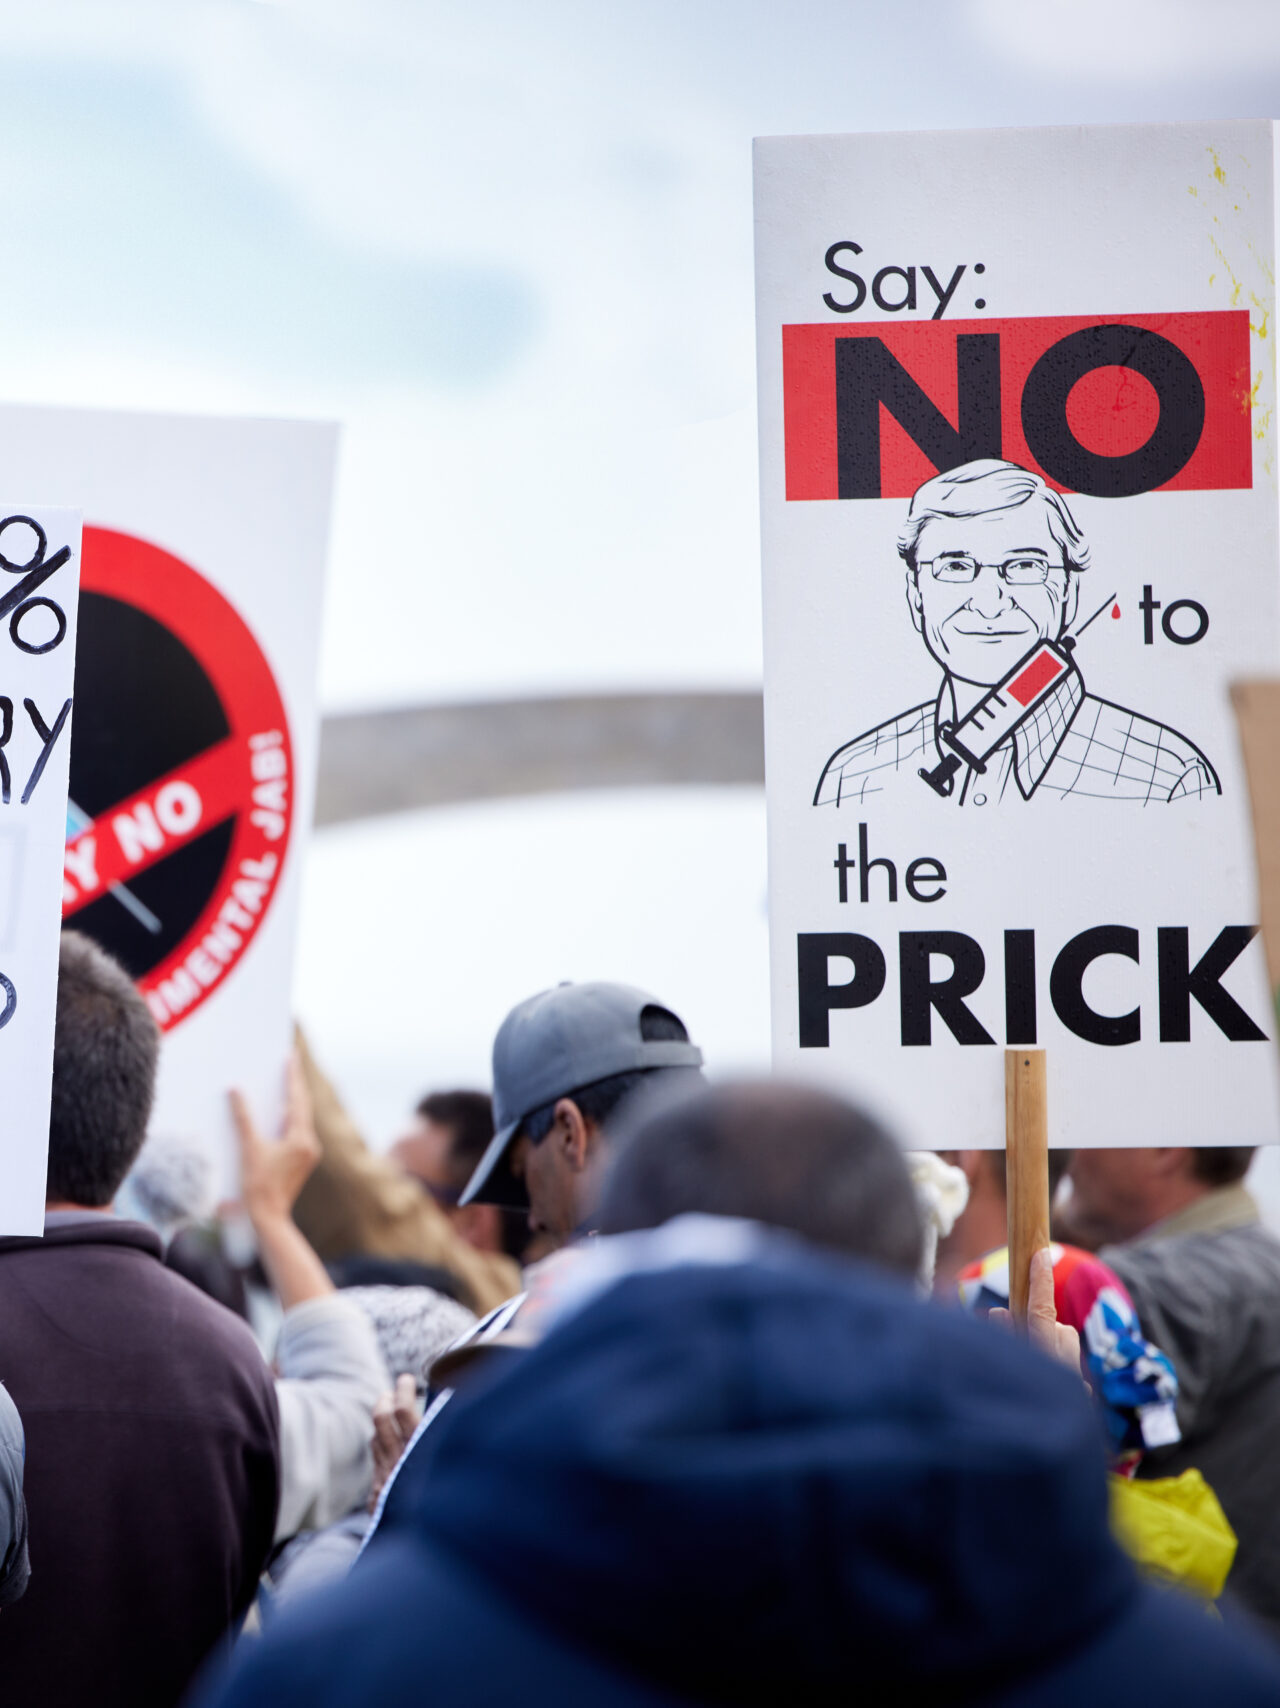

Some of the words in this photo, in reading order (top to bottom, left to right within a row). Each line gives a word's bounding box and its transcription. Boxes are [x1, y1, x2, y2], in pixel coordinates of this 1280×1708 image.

[822, 240, 987, 320] Say:
[834, 323, 1206, 500] NO
[1138, 584, 1210, 646] to
[112, 779, 203, 865] NO
[833, 822, 948, 903] the
[796, 924, 1272, 1049] PRICK
